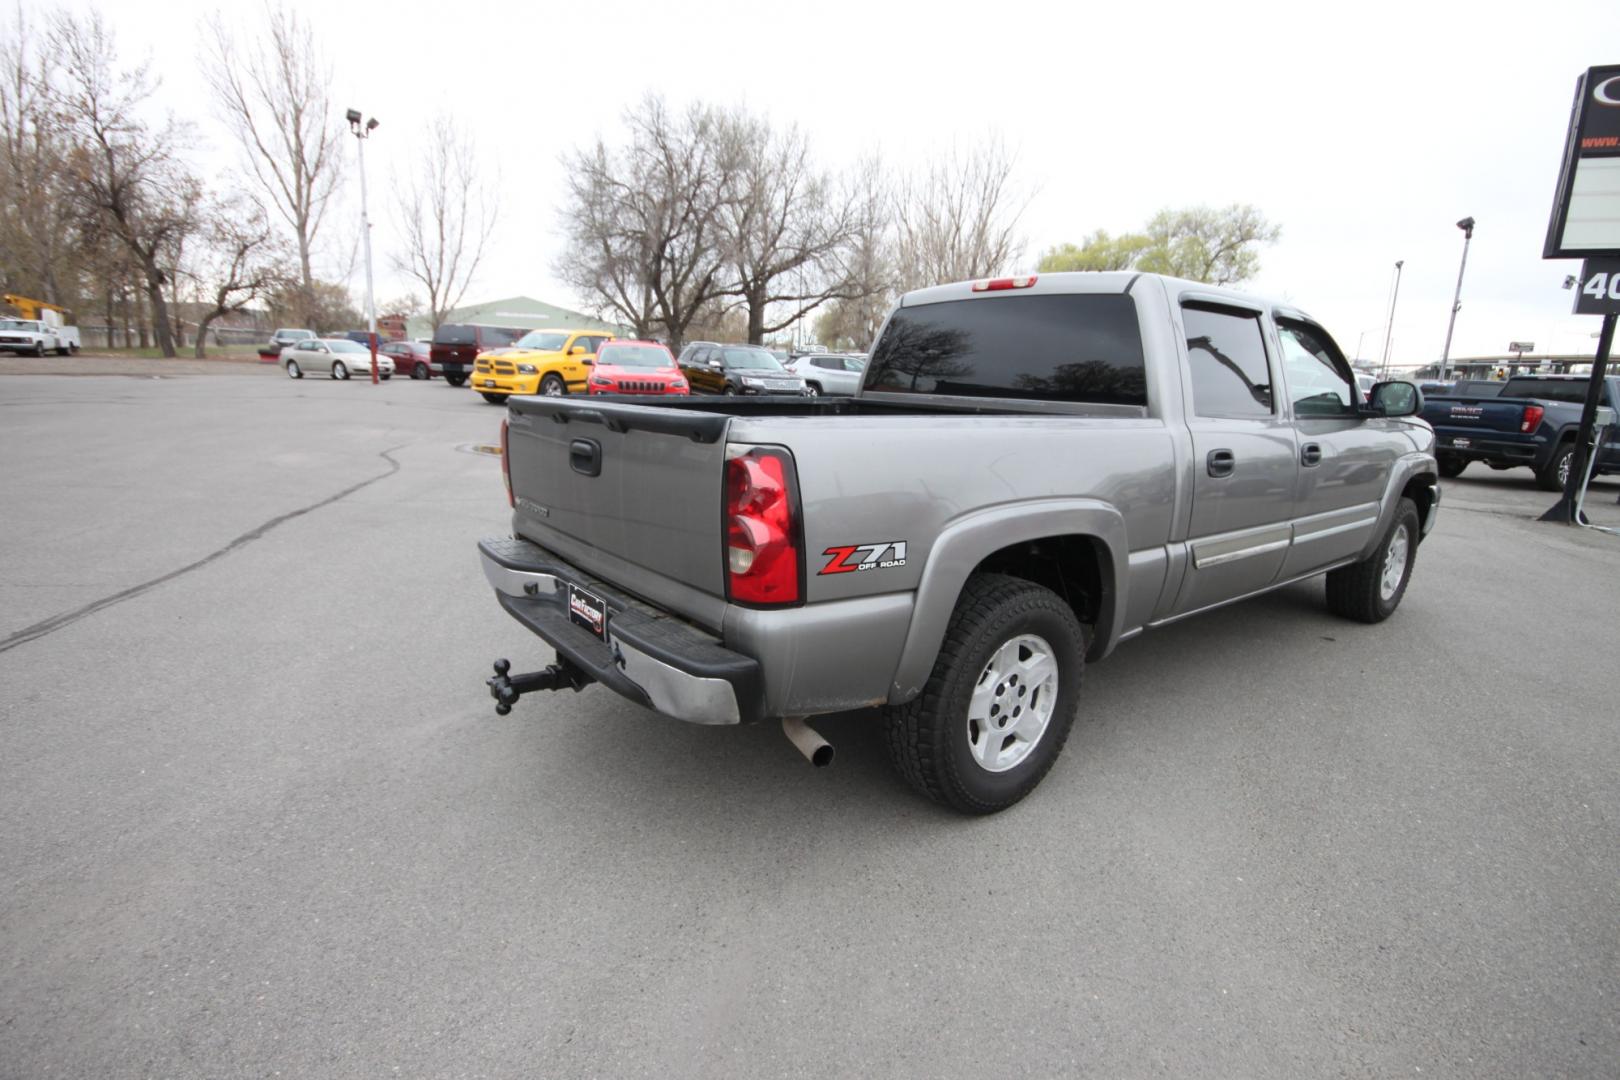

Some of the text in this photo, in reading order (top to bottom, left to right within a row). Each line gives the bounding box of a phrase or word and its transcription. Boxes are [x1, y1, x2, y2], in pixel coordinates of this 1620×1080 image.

[816, 540, 907, 576] Z71
[858, 559, 906, 571] OFF ROAD
